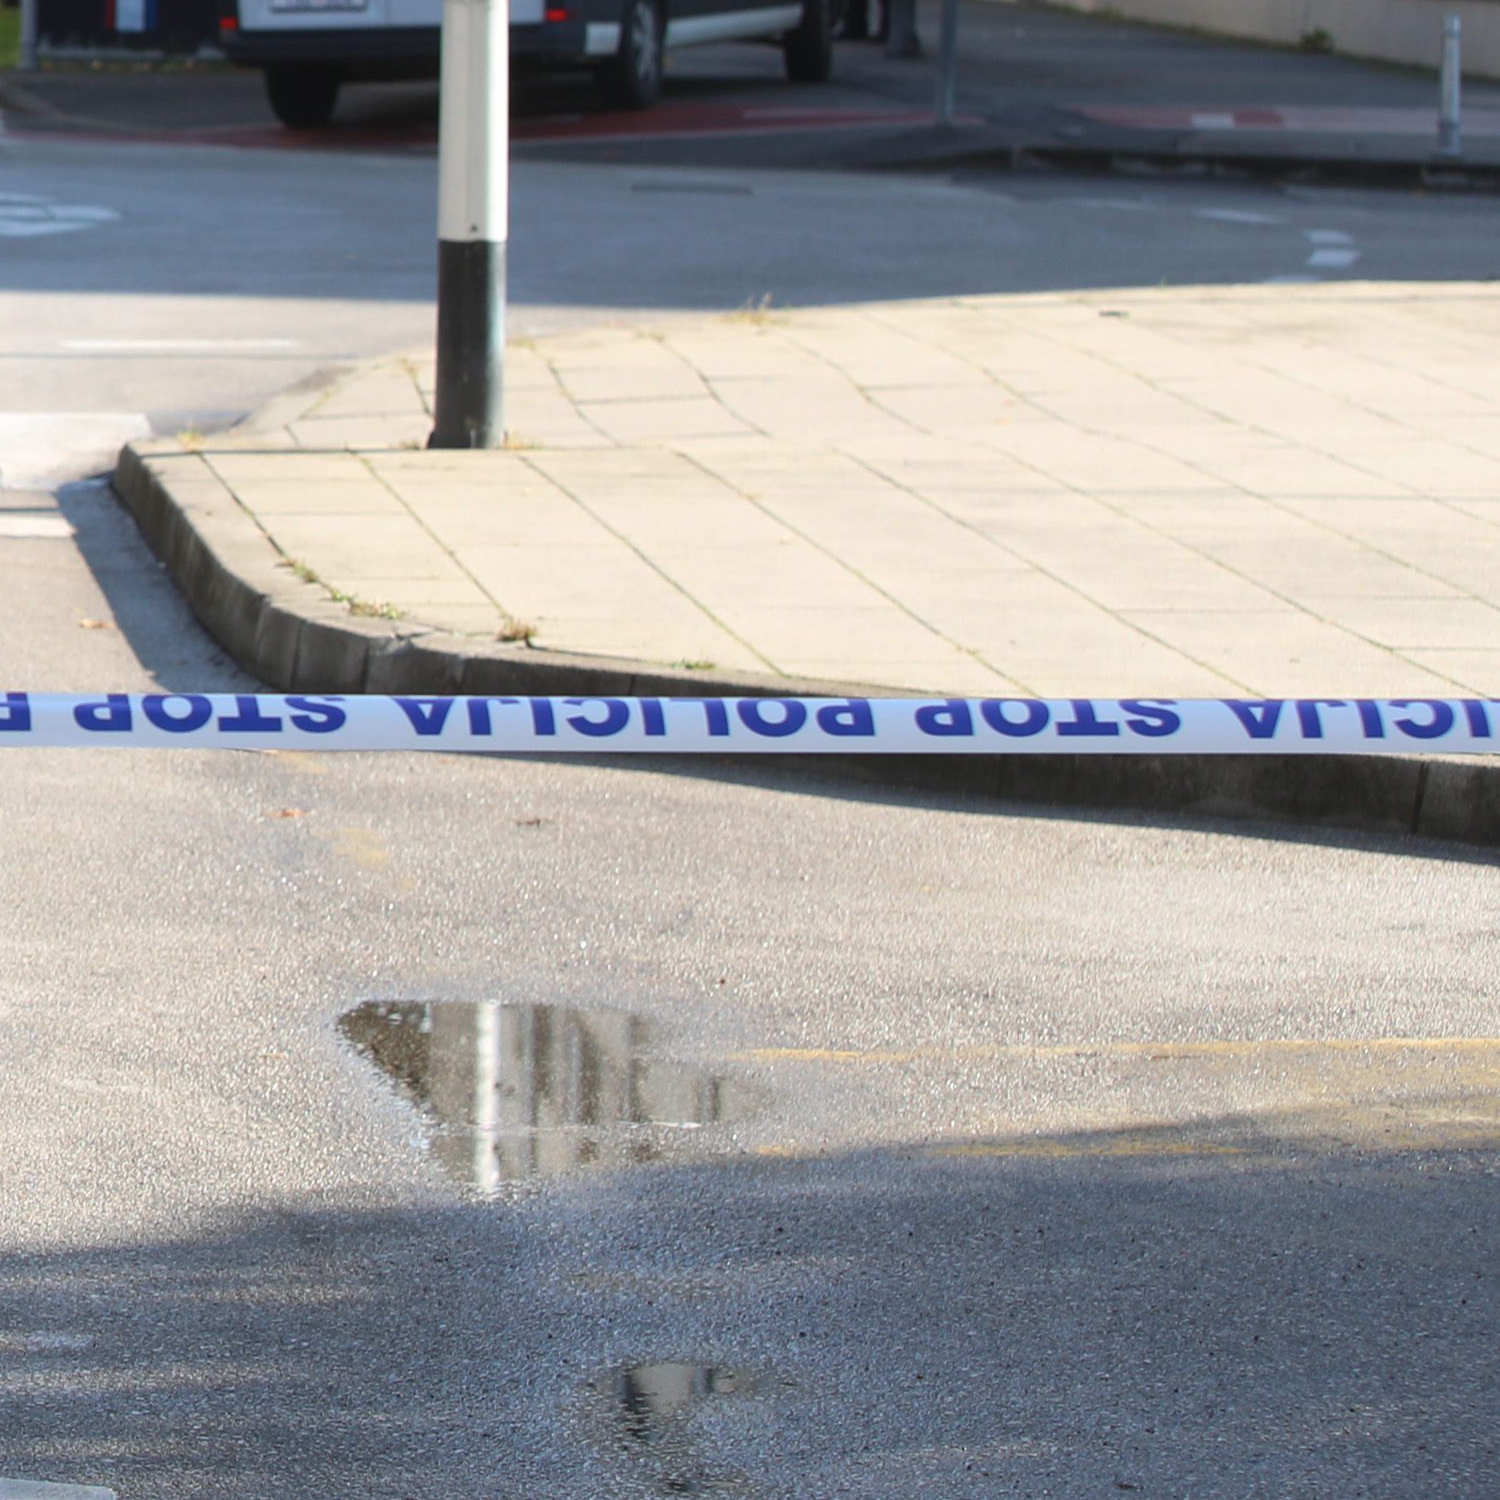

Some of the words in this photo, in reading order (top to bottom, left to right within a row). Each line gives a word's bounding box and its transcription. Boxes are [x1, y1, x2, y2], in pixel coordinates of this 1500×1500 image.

[73, 695, 346, 733] STOP
[396, 698, 875, 737] POLICIJA
[915, 699, 1181, 738] STOP
